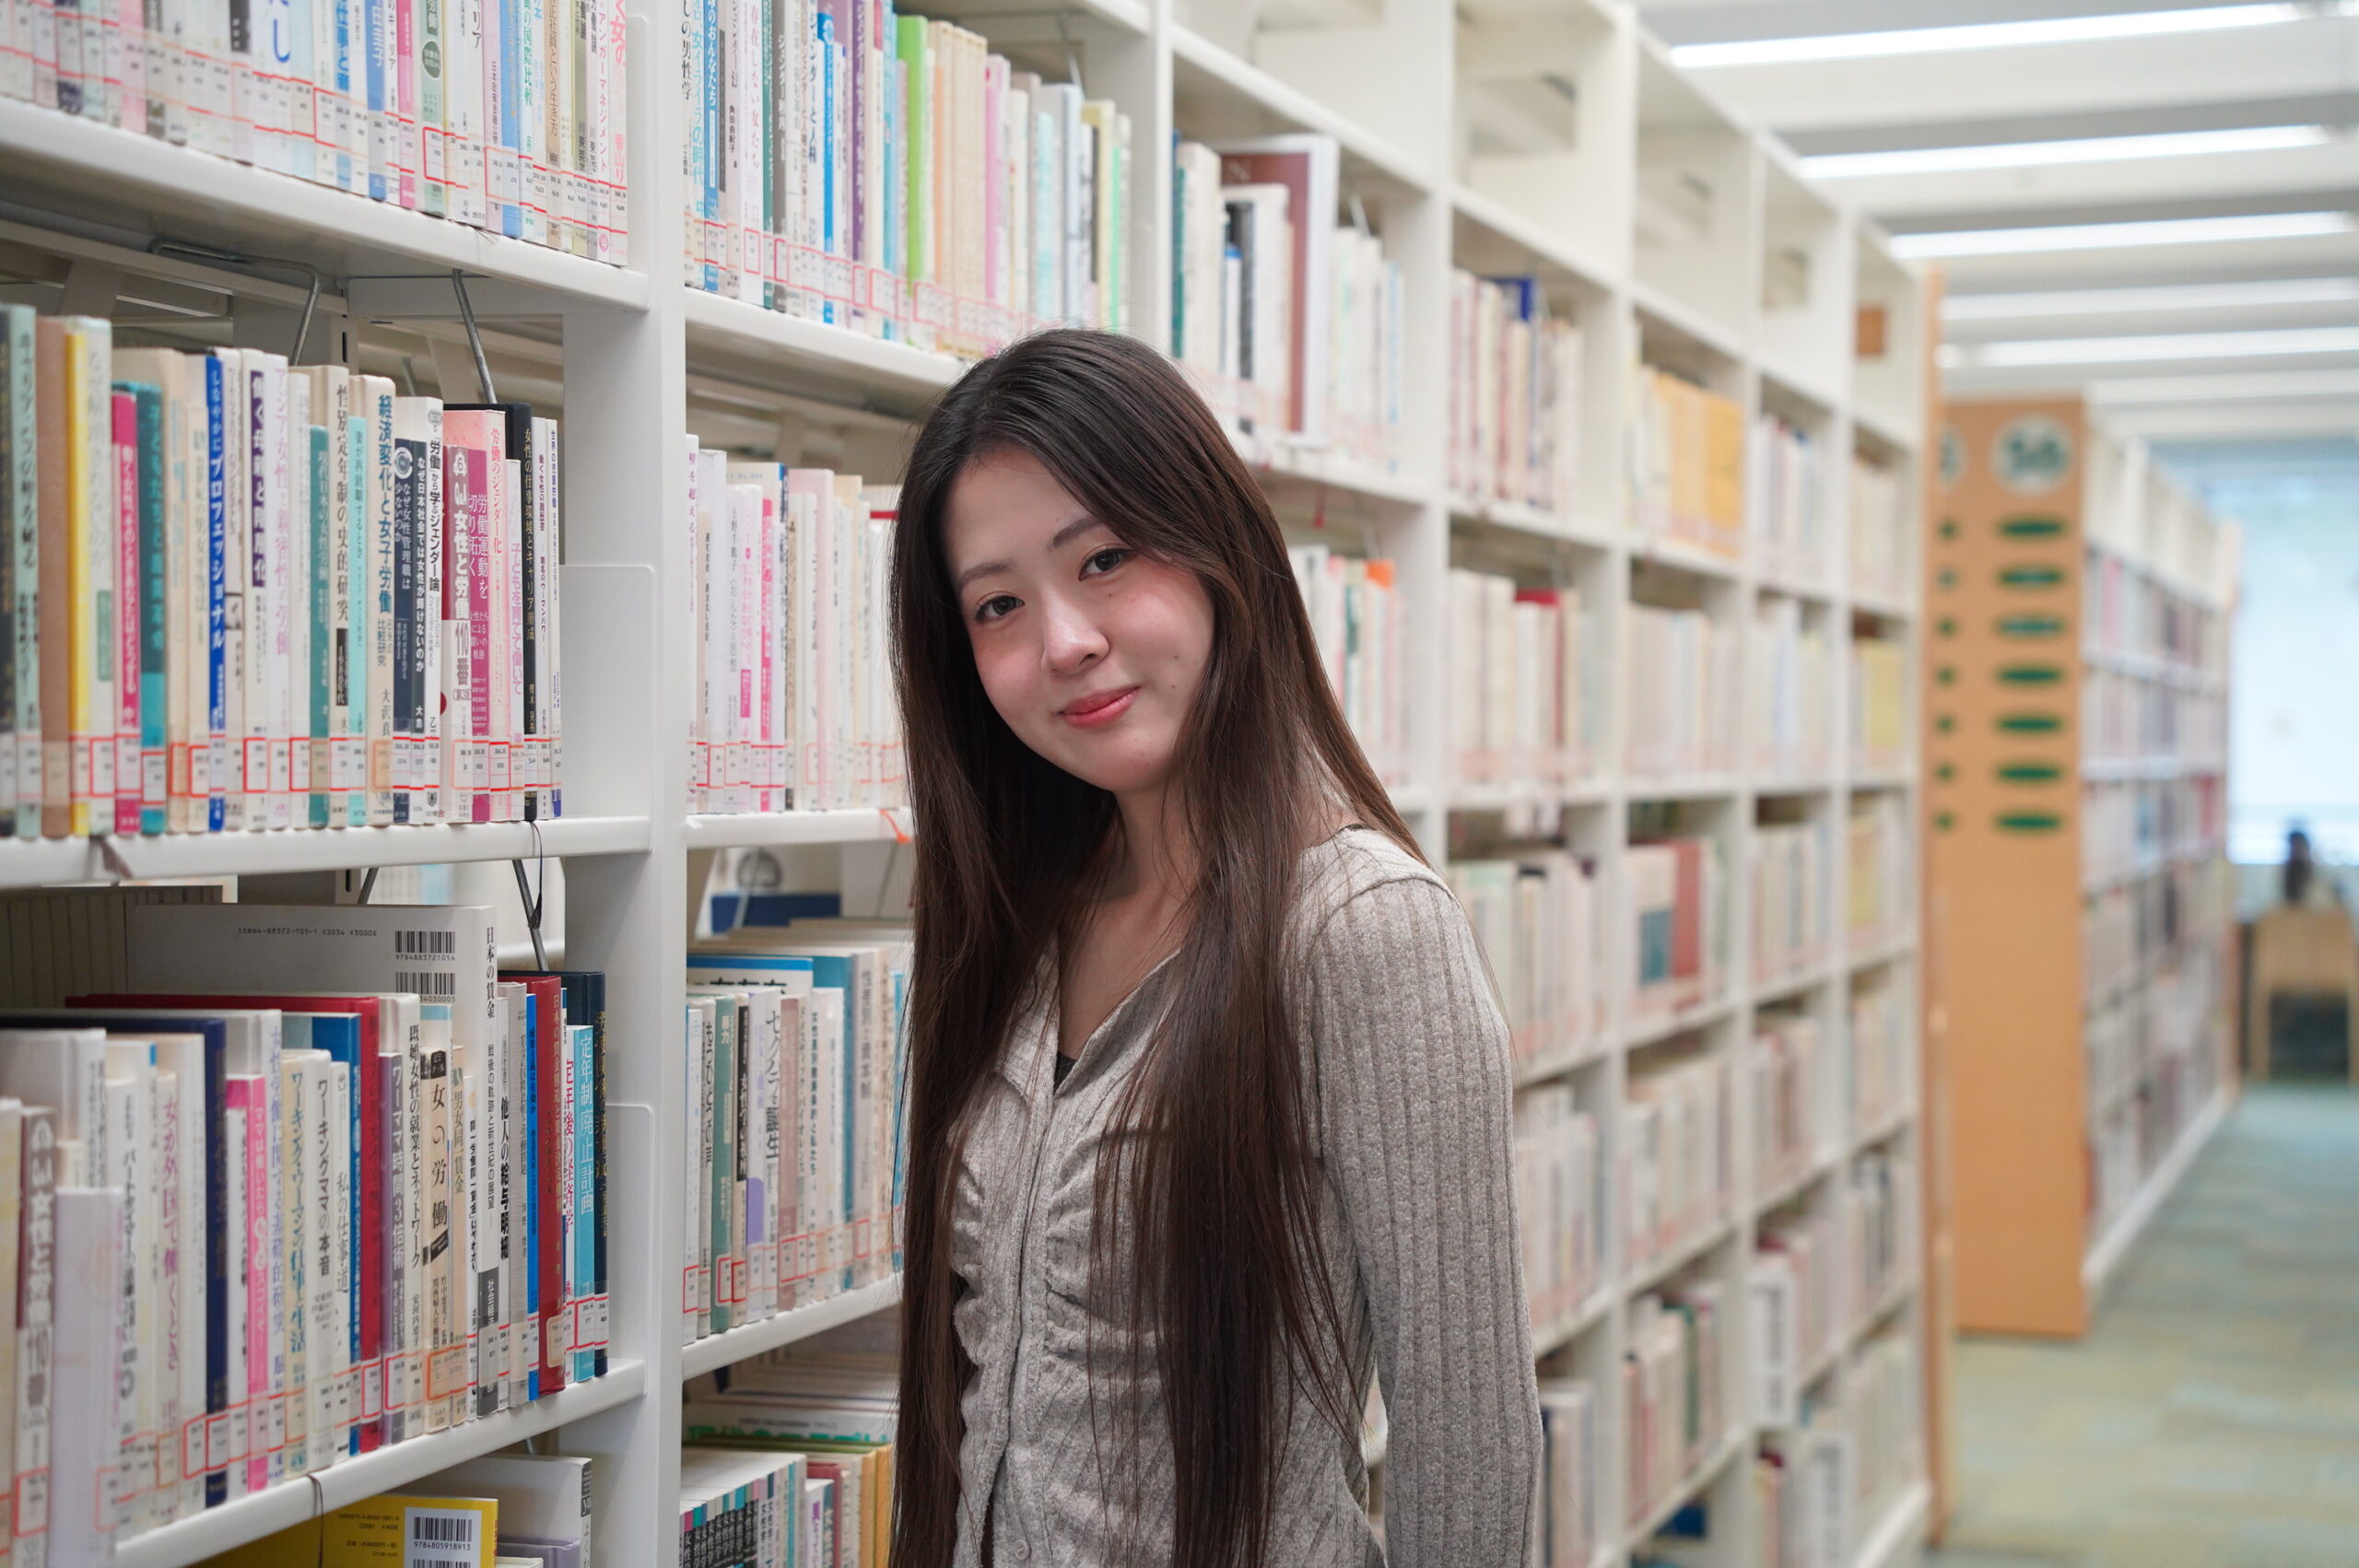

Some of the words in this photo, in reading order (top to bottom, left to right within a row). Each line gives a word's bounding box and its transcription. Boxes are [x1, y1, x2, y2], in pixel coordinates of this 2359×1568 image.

[378, 393, 393, 614] 経済変化と女子労働
[395, 954, 455, 962] 9784883721054
[419, 995, 455, 1003] 34030005
[317, 1078, 330, 1278] ワーキングママの本音
[392, 1064, 405, 1270] ワーママ時間3倍術
[409, 1024, 422, 1270] 既婚女性の就業とネットワーク
[580, 1033, 595, 1216] 定年制廃止計画
[414, 1540, 472, 1551] 9784805918913
